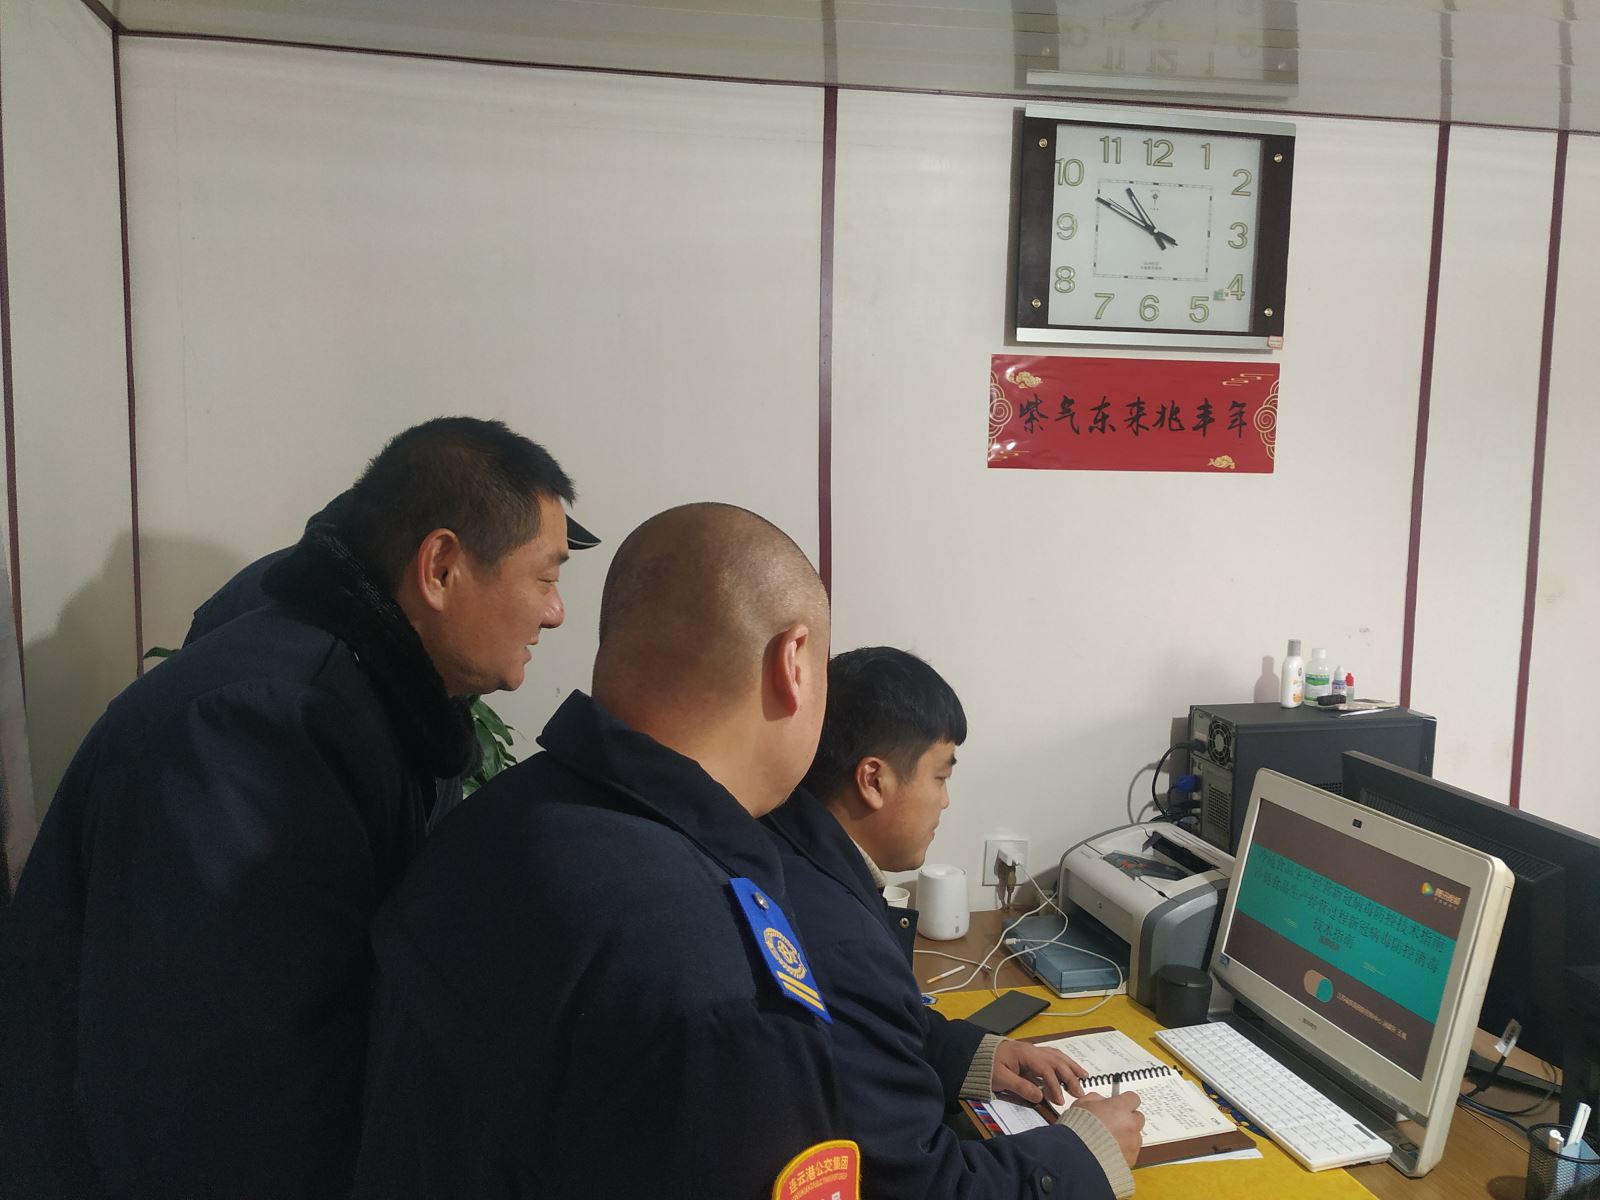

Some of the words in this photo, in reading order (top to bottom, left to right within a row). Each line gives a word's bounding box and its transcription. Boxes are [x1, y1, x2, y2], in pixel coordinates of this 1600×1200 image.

[1100, 135, 1122, 164] 11
[1142, 138, 1174, 167] 12
[1201, 142, 1211, 170] 1
[1055, 158, 1085, 186] 10
[1231, 168, 1253, 197] 2
[1056, 212, 1078, 240] 9
[1228, 221, 1248, 249] 3
[1054, 266, 1076, 293] 8
[1226, 273, 1246, 300] 4
[1094, 292, 1115, 320] 7
[1139, 294, 1160, 321] 6
[1189, 296, 1210, 323] 5
[1019, 393, 1248, 438] 紫气东来兆丰年
[789, 1155, 849, 1195] 连云港公交集团
